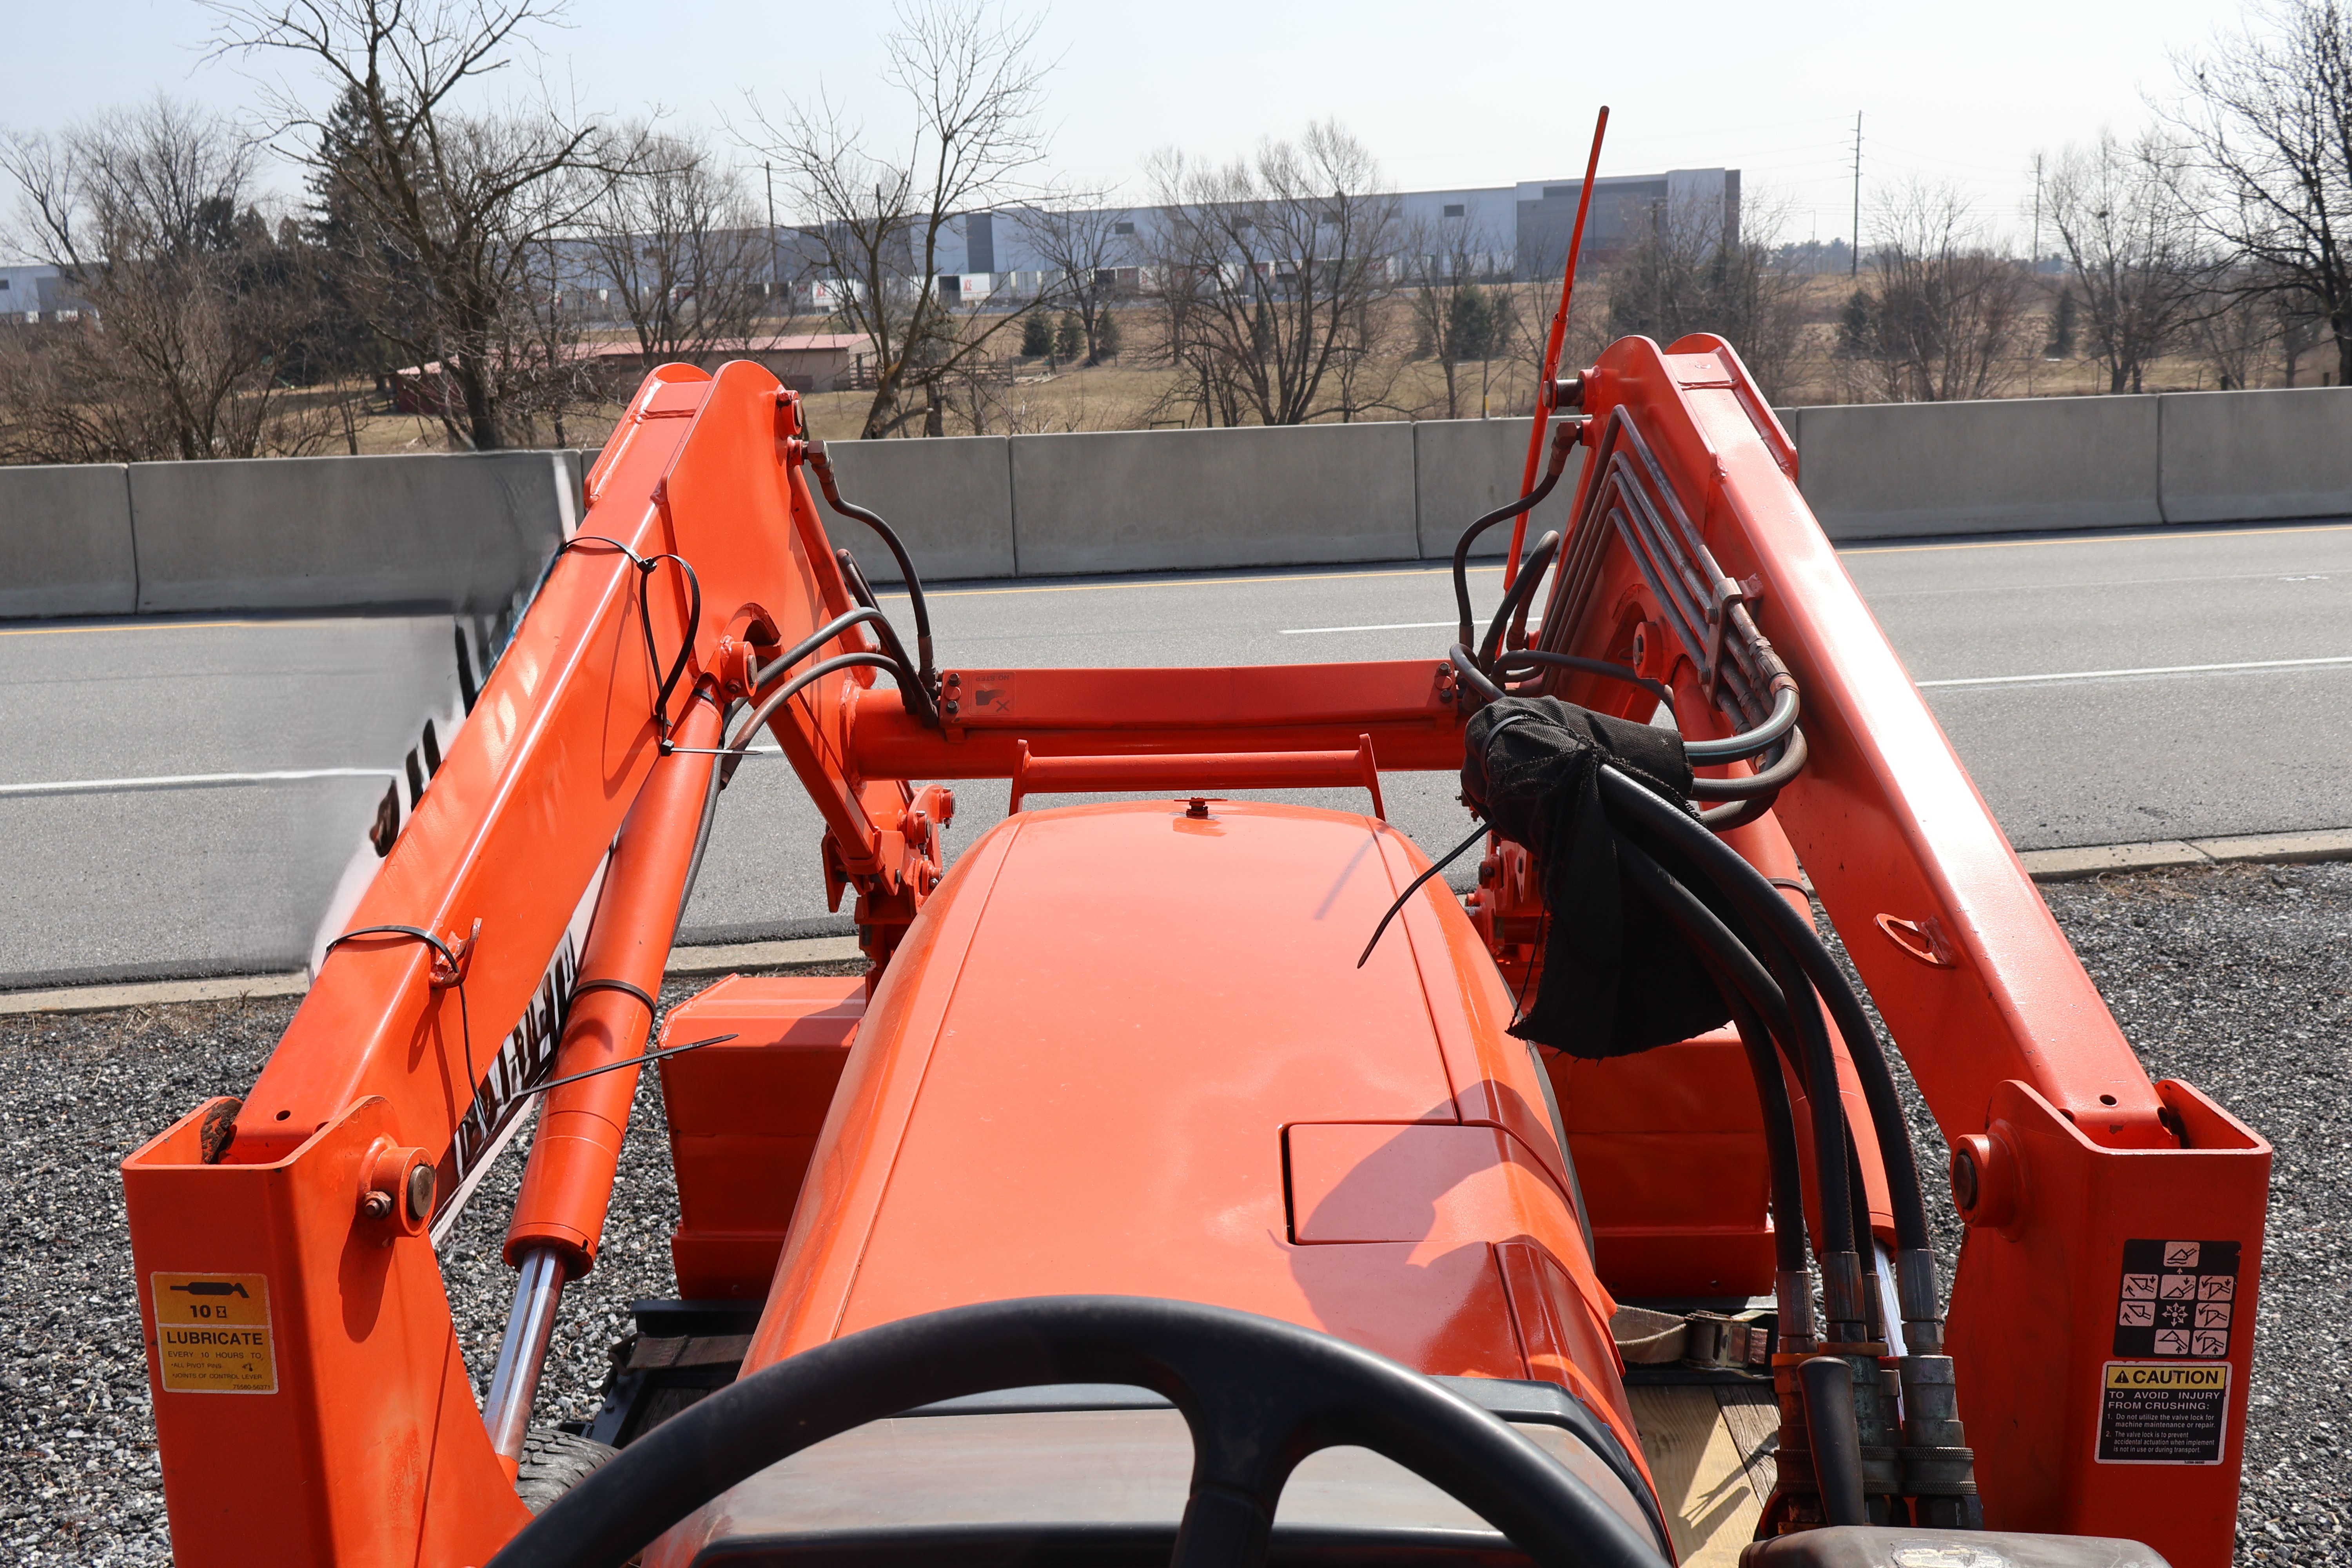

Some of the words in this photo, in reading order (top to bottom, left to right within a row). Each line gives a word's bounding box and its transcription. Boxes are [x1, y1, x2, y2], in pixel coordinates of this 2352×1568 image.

[190, 1305, 211, 1318] 10
[167, 1331, 263, 1345] LUBRICATE
[2133, 1370, 2219, 1384] CAUTION
